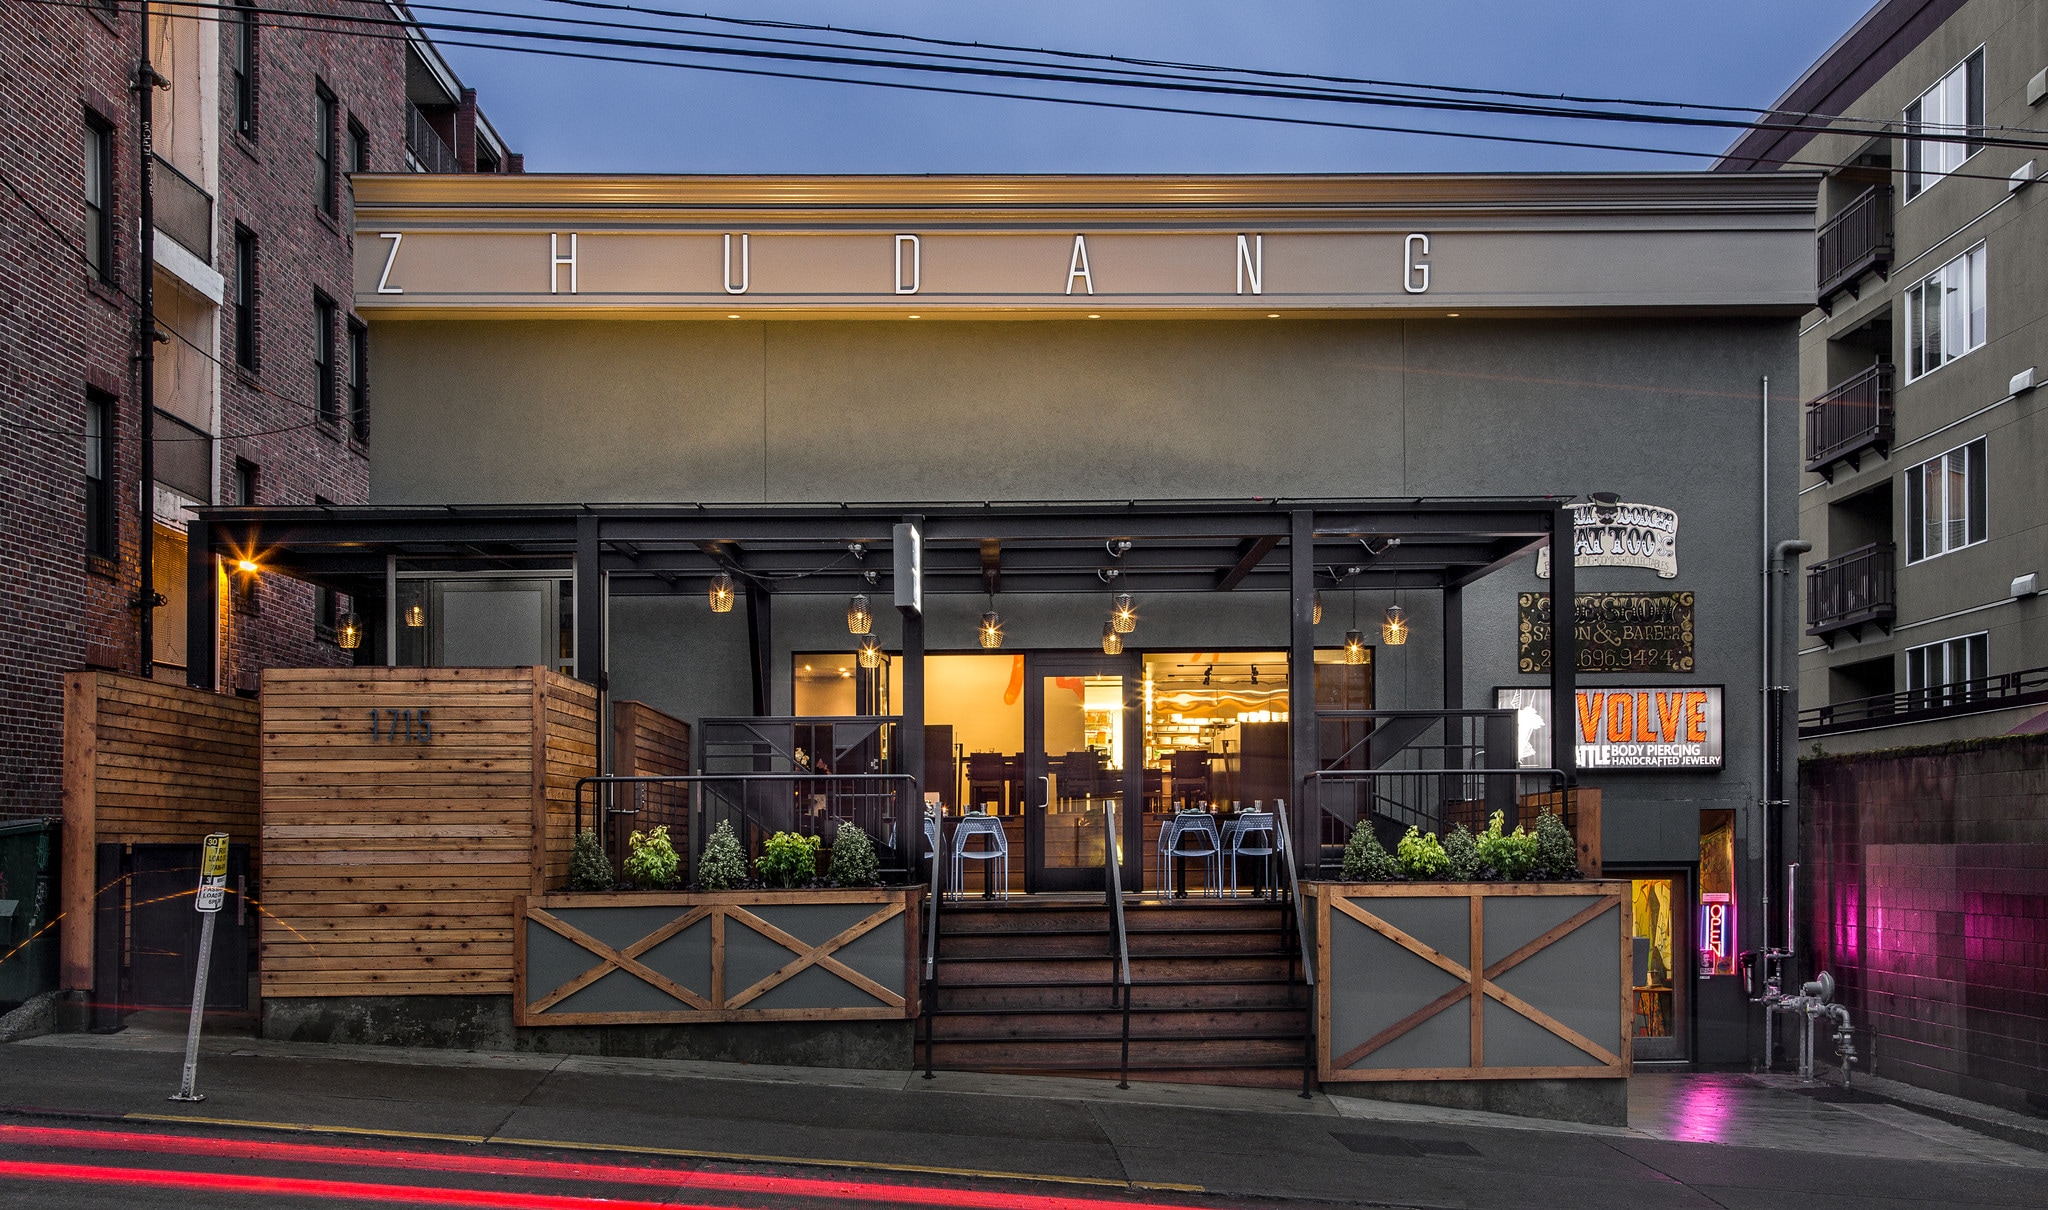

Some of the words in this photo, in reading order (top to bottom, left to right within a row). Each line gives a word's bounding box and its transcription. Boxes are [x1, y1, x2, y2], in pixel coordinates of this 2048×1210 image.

[378, 232, 1430, 295] ZHUDANG
[1617, 505, 1675, 533] DODGER
[1574, 526, 1656, 557] ATTOO
[1593, 622, 1621, 646] &
[1622, 625, 1680, 641] BARBER
[1541, 648, 1674, 668] 2.696.9424
[368, 708, 432, 742] 1715
[1575, 691, 1707, 743] VOLVE
[1611, 745, 1643, 757] BODY
[1647, 745, 1700, 758] PIERCING
[1612, 757, 1679, 767] HANDCRAFTED
[1681, 756, 1721, 766] JEWELRY
[207, 838, 218, 846] 30
[1710, 904, 1722, 957] OPEN
